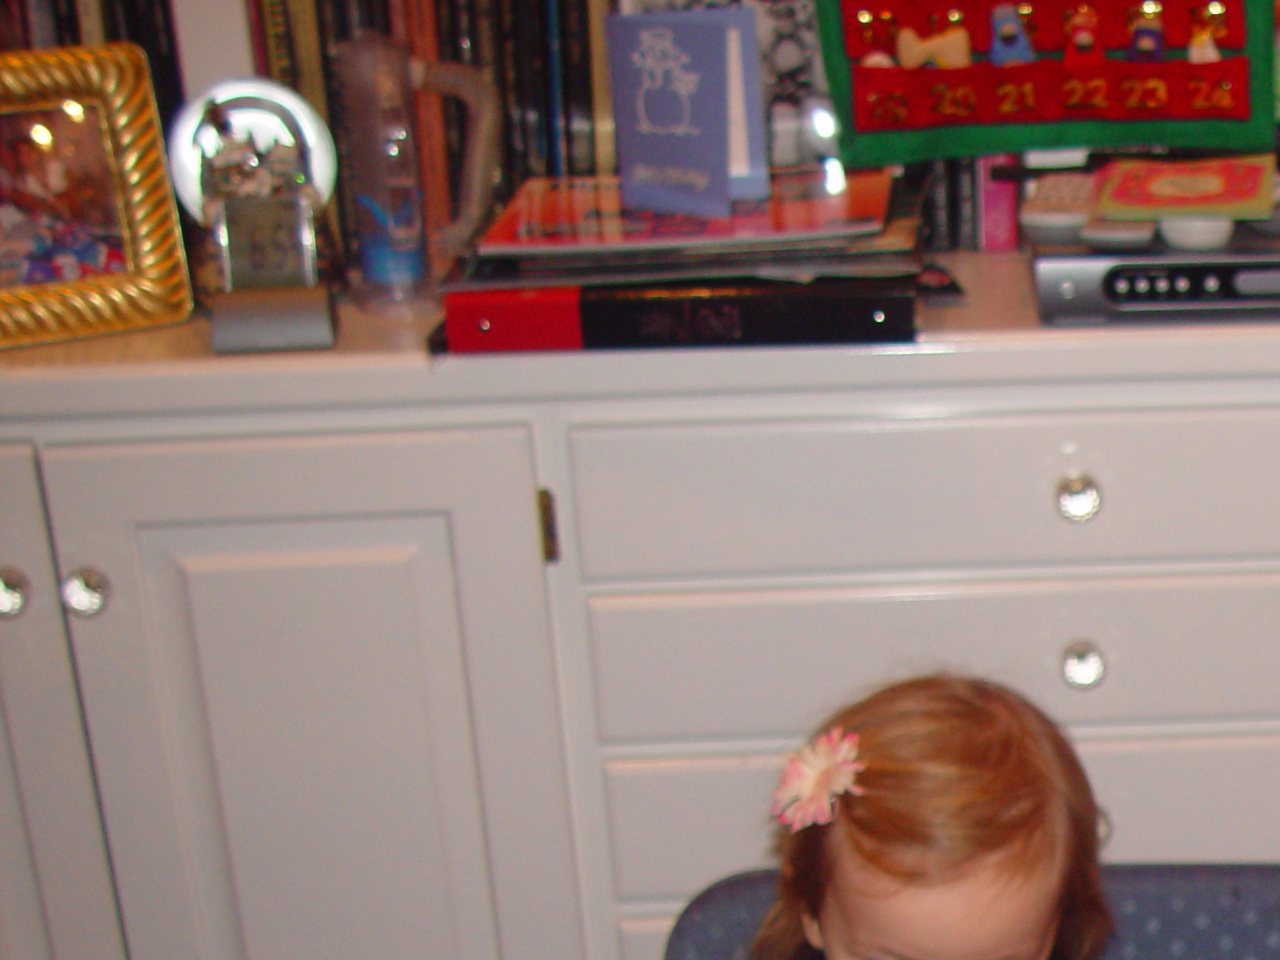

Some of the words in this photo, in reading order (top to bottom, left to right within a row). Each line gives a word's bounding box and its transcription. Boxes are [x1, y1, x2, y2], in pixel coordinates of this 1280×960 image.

[930, 81, 977, 117] 20
[995, 82, 1036, 114] 21
[1061, 77, 1110, 109] 22
[1119, 77, 1168, 109] 23
[1187, 77, 1235, 111] 24
